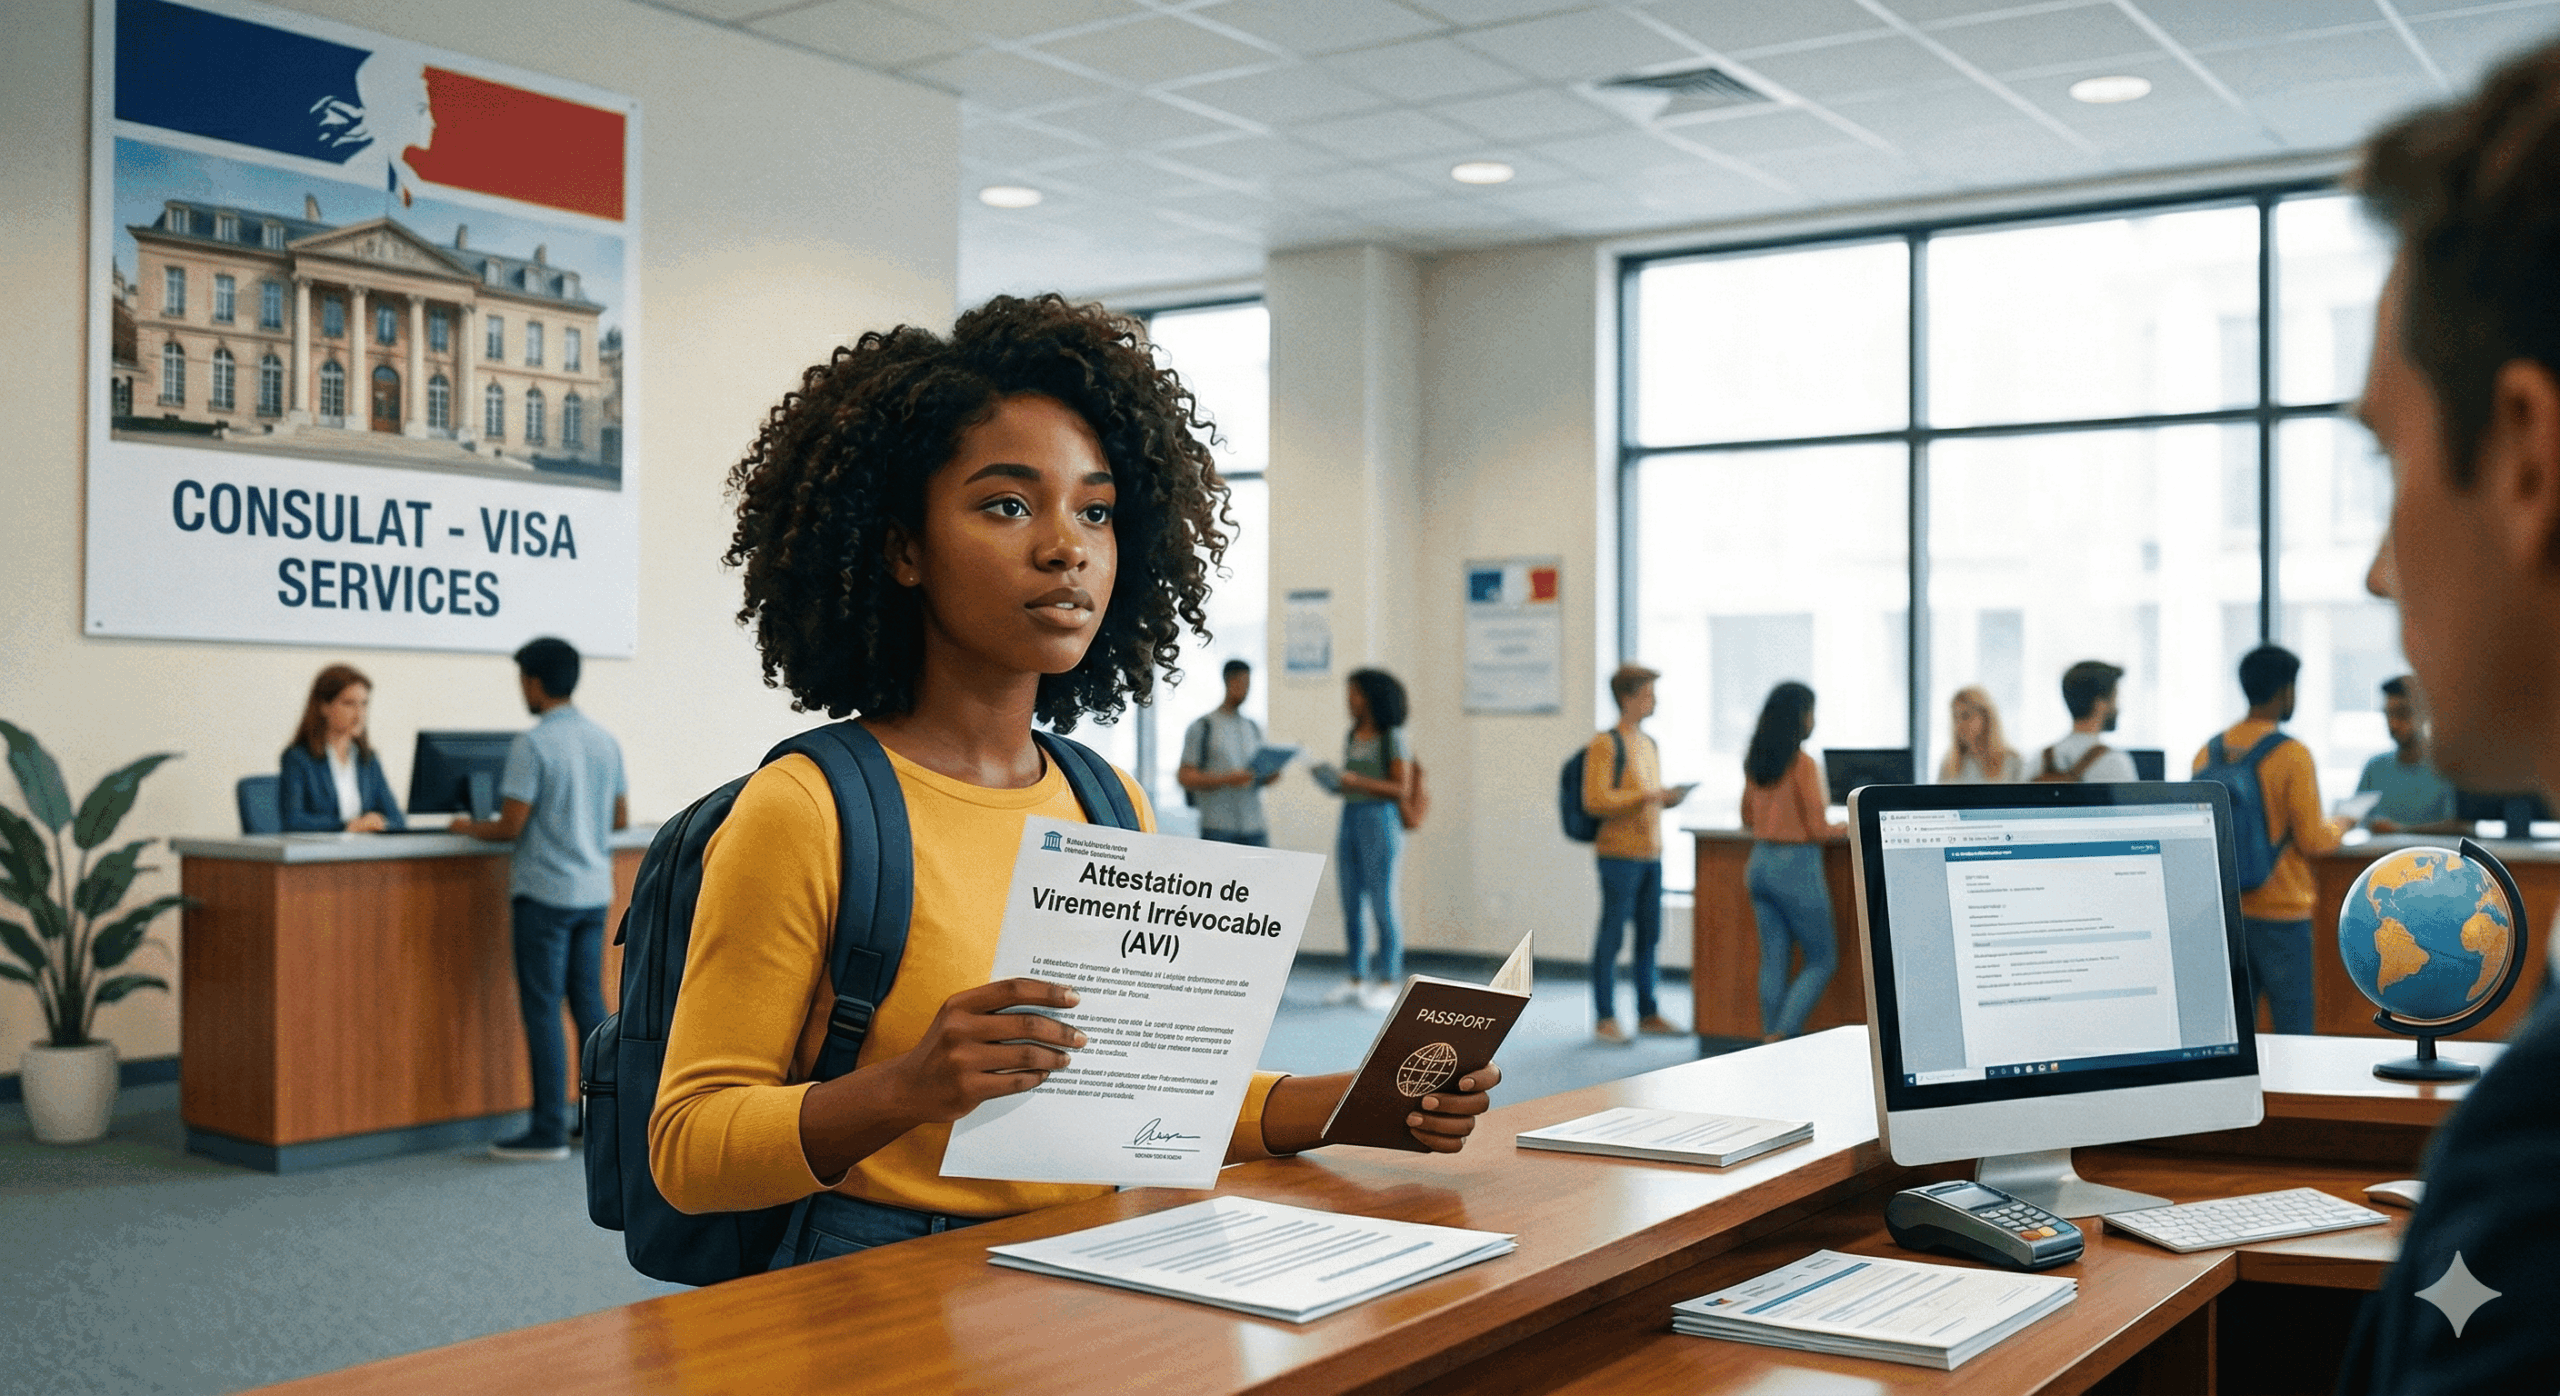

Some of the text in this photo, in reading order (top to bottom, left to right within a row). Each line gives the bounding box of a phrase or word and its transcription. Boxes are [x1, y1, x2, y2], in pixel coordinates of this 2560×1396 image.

[171, 478, 578, 561] CONSULAT - VISA
[276, 556, 501, 619] SERVICES
[1078, 860, 1250, 904] Attestation de
[1031, 886, 1283, 939] Virement Irrévocable
[1120, 929, 1181, 964] (AVI)
[1415, 1008, 1496, 1031] PASSPORT
